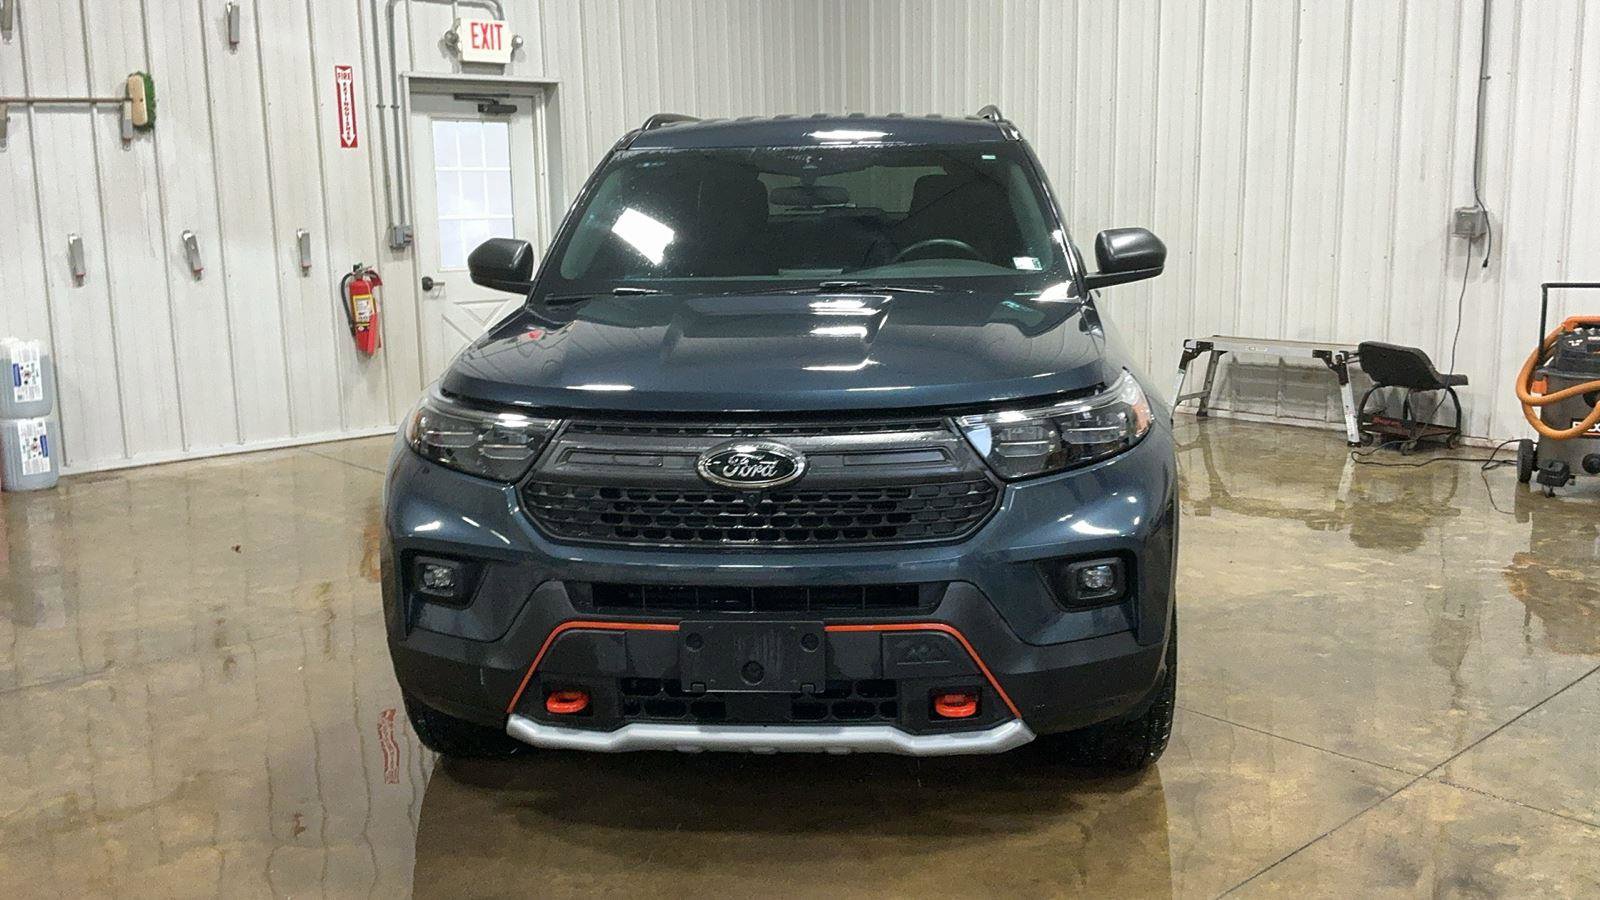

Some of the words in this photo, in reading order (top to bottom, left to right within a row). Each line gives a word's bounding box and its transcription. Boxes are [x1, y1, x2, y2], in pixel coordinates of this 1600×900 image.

[470, 22, 503, 50] EXIT
[337, 72, 350, 80] FIRE
[342, 81, 351, 141] EXTINGUISHER
[722, 453, 779, 477] Ford
